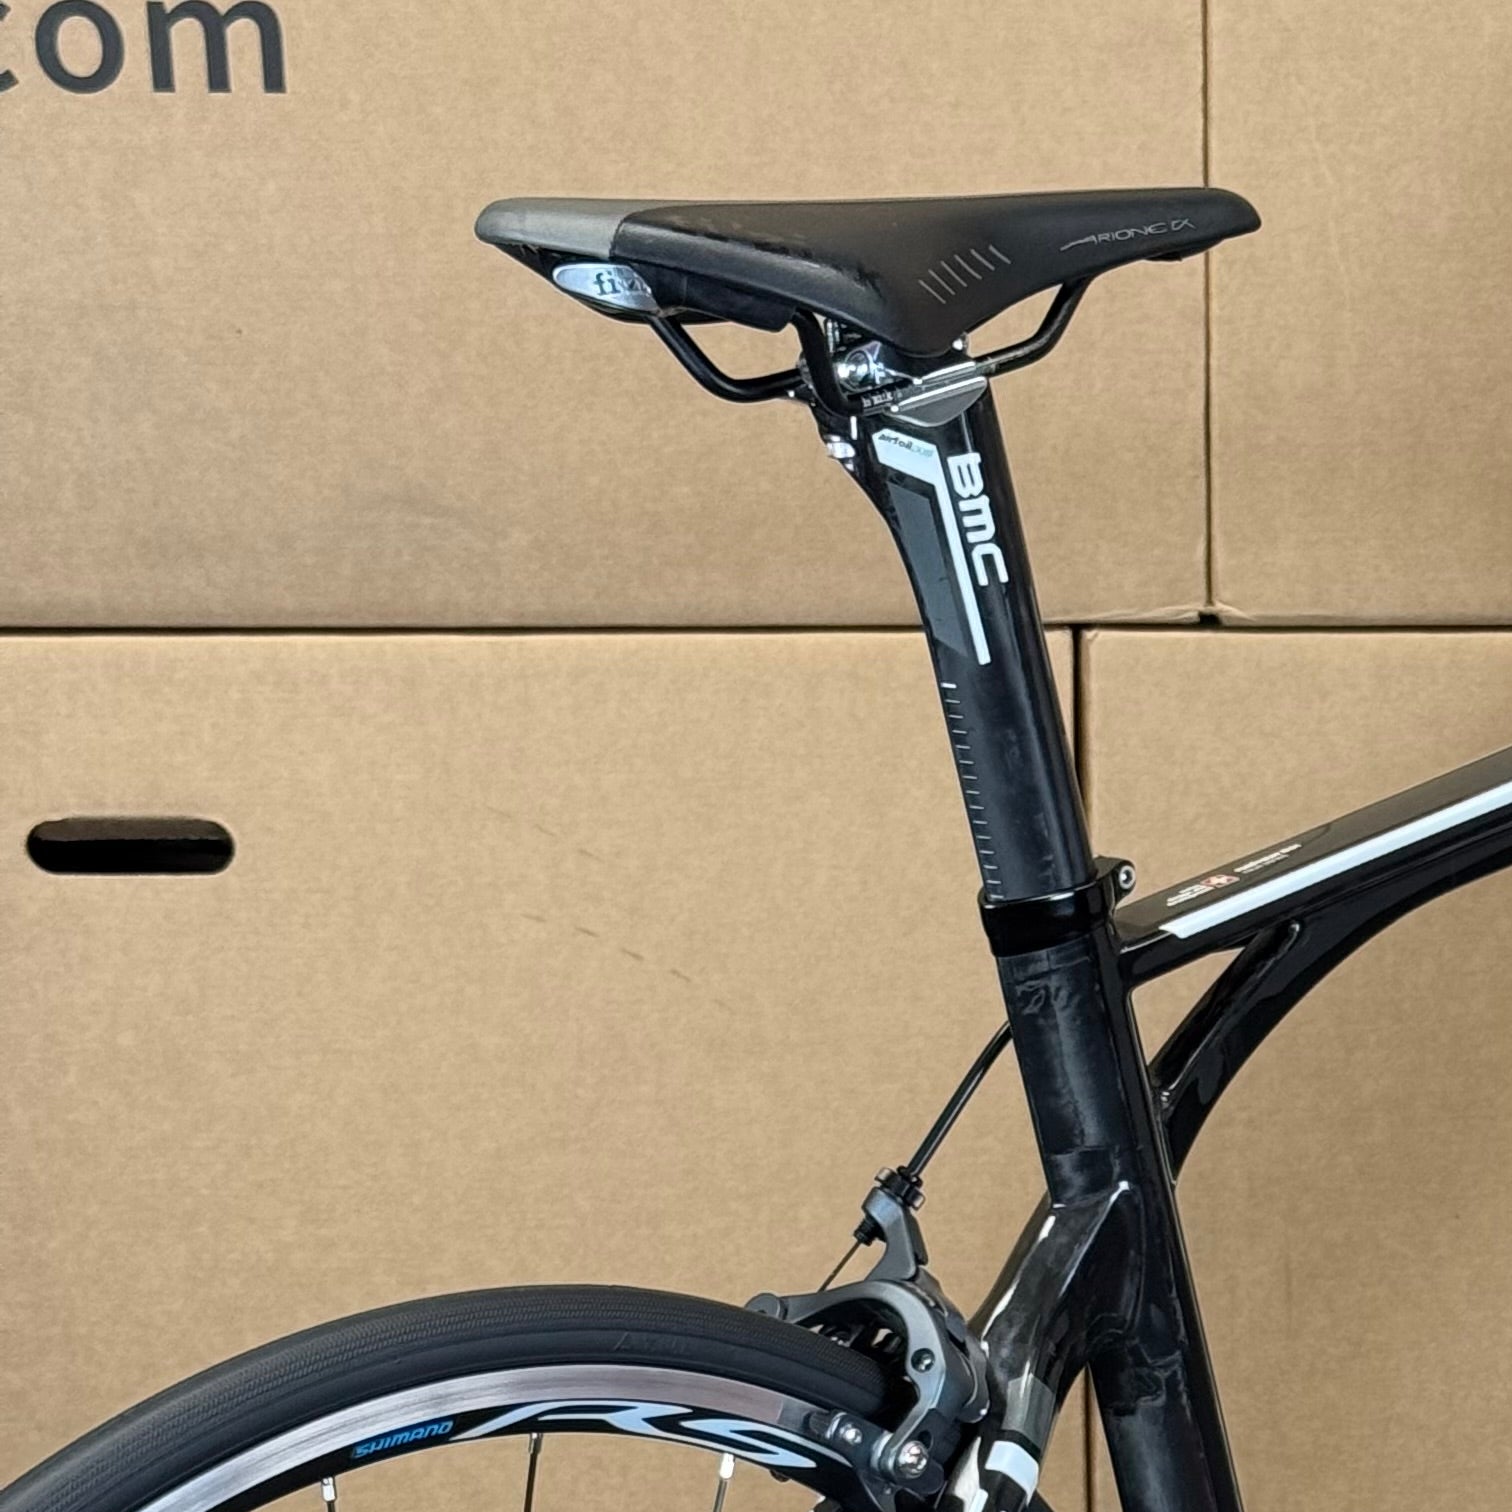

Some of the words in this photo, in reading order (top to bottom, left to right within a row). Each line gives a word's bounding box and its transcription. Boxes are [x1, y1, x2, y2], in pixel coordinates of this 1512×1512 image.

[0, 0, 287, 95] om
[946, 451, 1010, 588] BMC
[352, 1420, 454, 1459] SHIMANO
